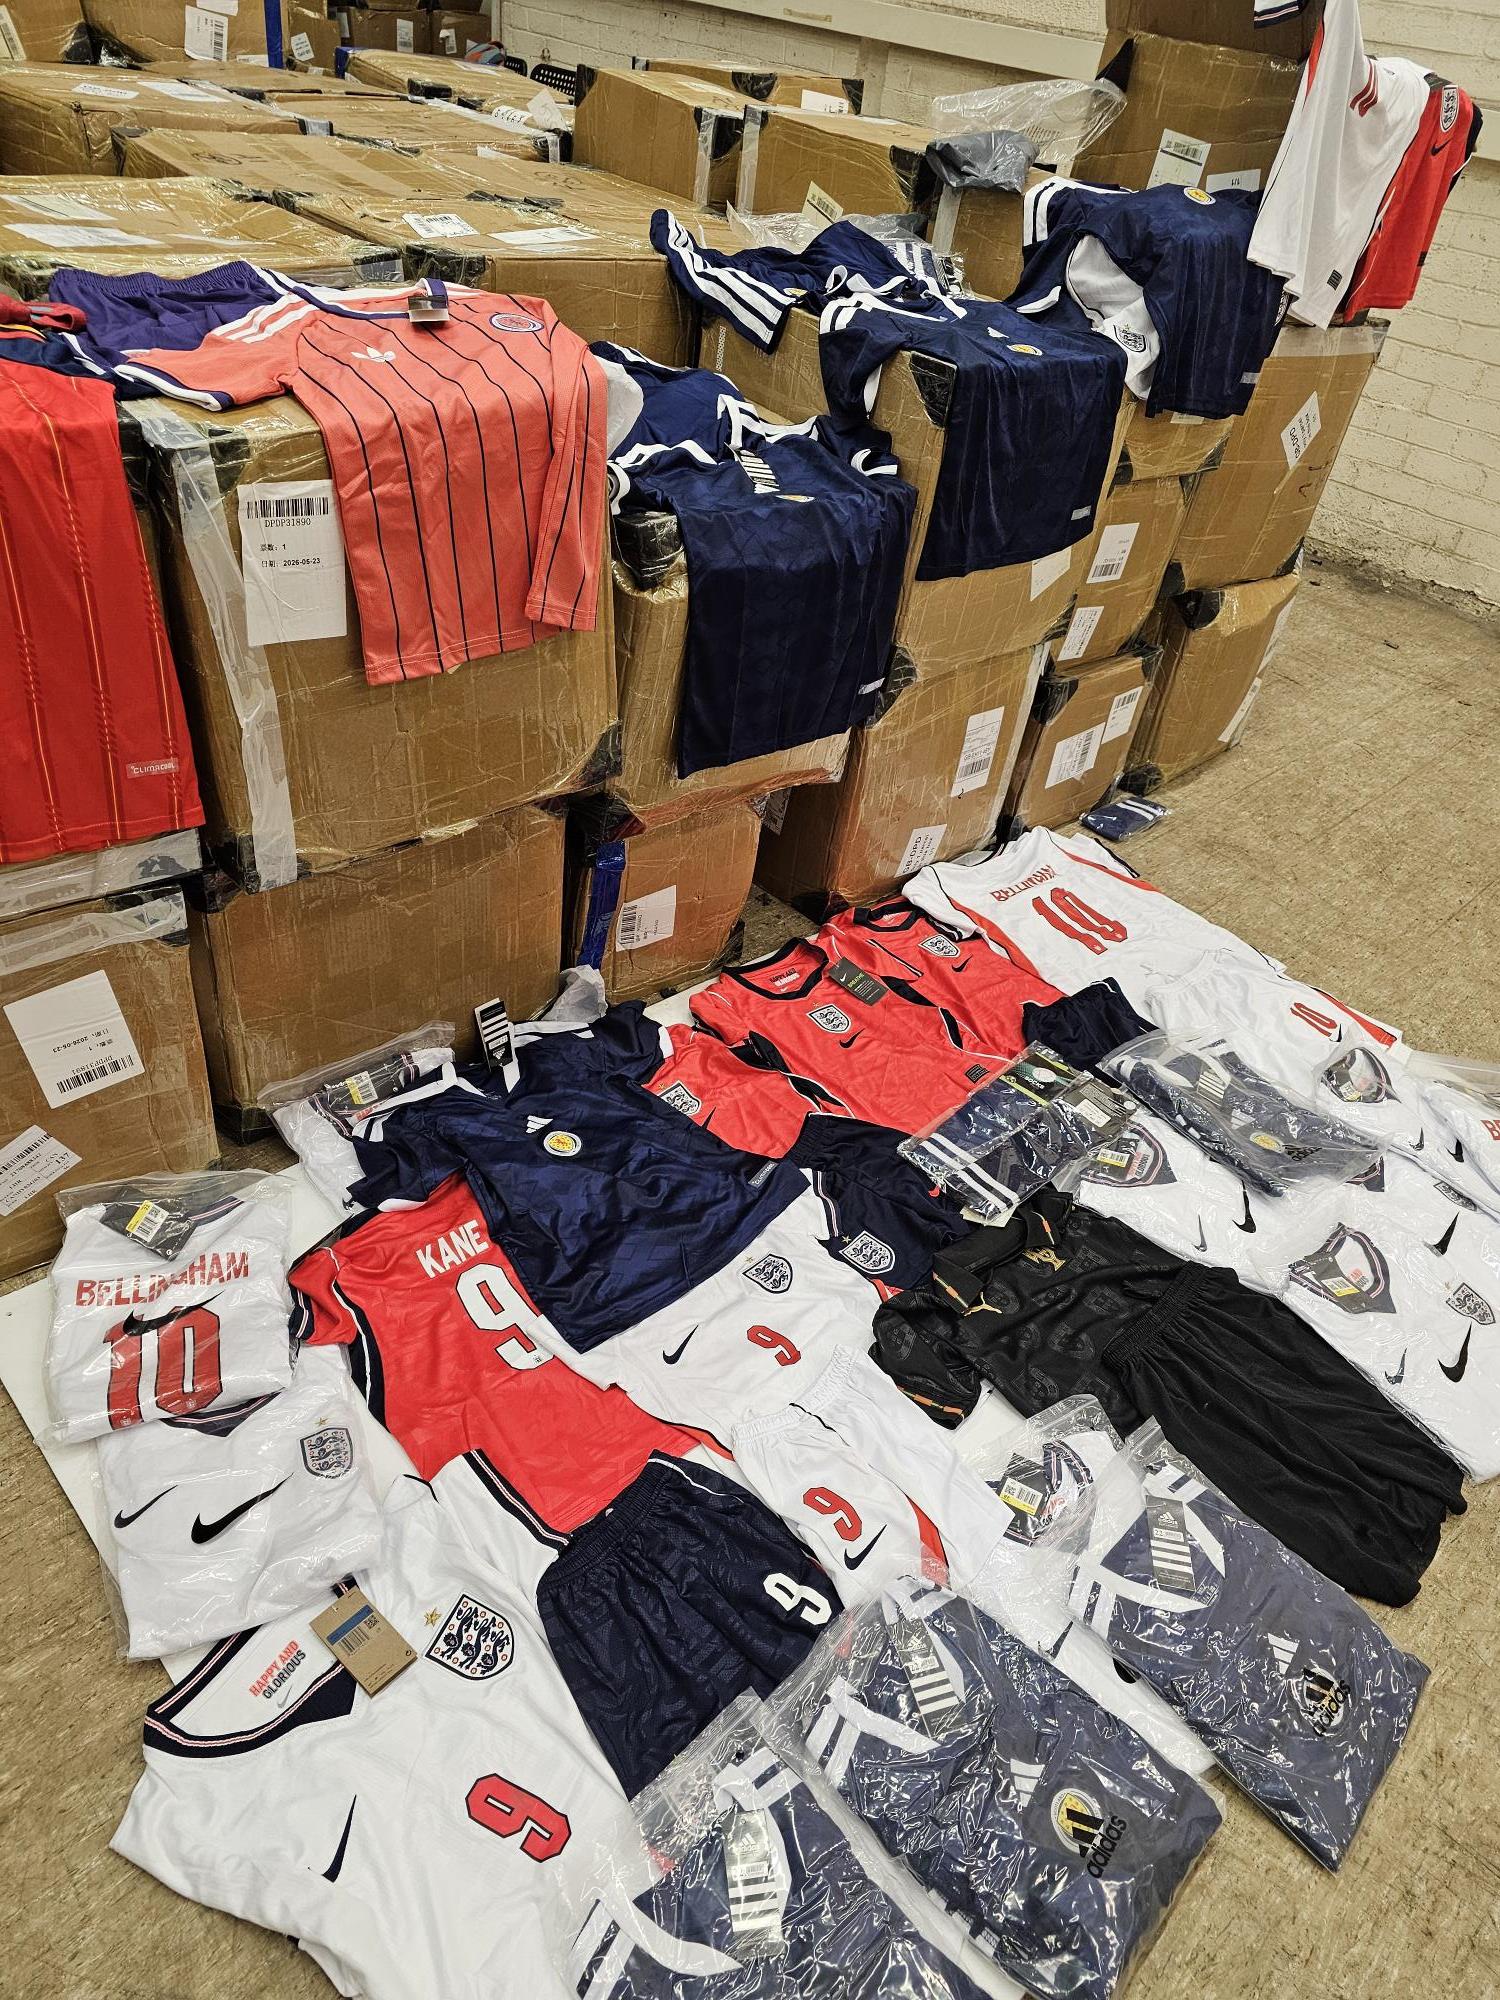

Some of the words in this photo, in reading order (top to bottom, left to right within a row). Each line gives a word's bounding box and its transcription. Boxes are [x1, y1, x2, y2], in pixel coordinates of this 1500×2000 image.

[283, 557, 321, 567] 2026-05-23
[1031, 887, 1128, 955] 10
[1290, 1002, 1338, 1038] 10
[416, 1219, 489, 1279] KANE
[456, 1263, 556, 1371] 9
[746, 1324, 802, 1367] 9
[103, 1305, 223, 1430] 10
[802, 1486, 863, 1542] 9
[763, 1572, 833, 1626] 9
[249, 1660, 280, 1697] HAPPY
[279, 1640, 300, 1664] AND
[262, 1650, 306, 1699] GLORIOUS
[1313, 1680, 1351, 1737] adidas
[465, 1772, 572, 1864] 9
[1087, 1815, 1127, 1879] adidas
